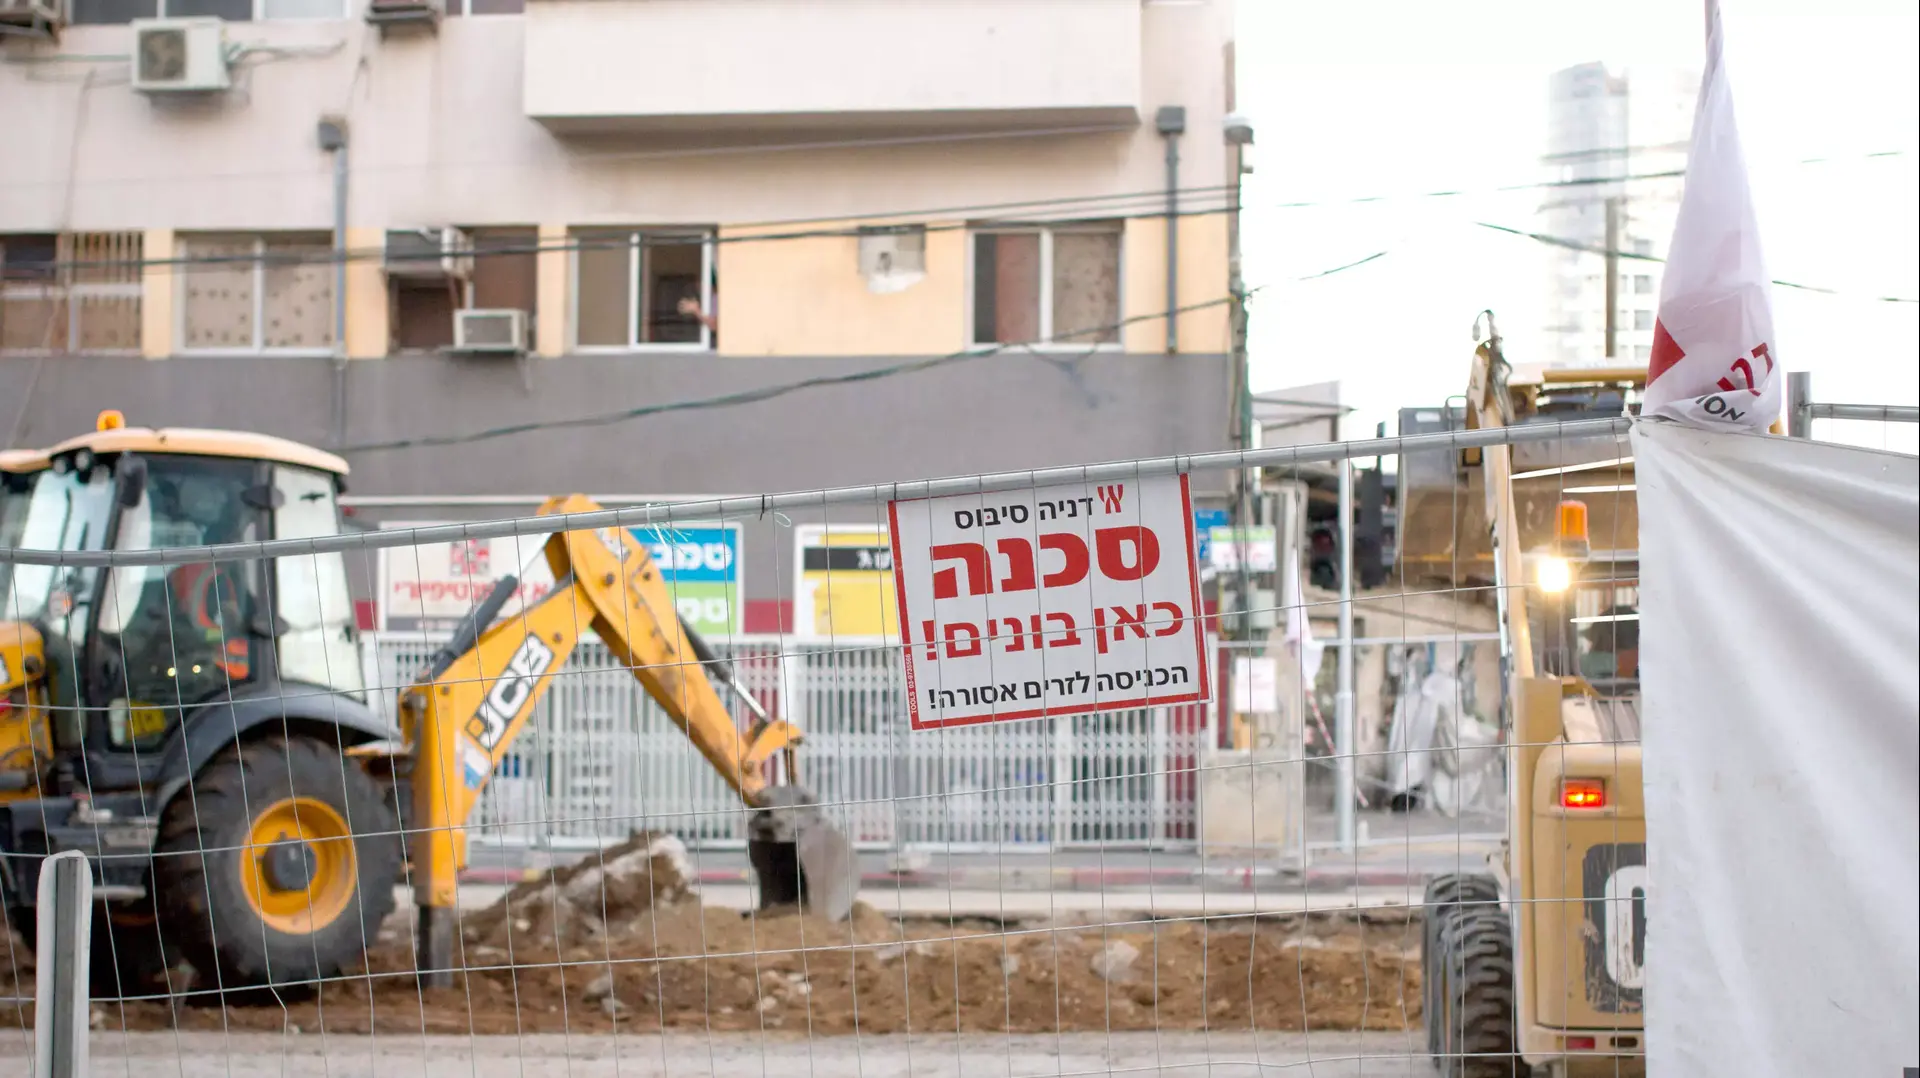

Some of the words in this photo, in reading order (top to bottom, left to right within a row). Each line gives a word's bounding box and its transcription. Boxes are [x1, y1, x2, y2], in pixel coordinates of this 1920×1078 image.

[955, 504, 1029, 529] סיבוס
[1039, 497, 1093, 521] דניה
[930, 526, 1160, 600] סכנה
[922, 612, 1081, 661] בונים!
[1094, 602, 1184, 654] כאן
[478, 634, 554, 750] JCB
[1024, 671, 1091, 699] לזרים
[1097, 665, 1189, 692] הכניסה
[909, 691, 917, 714] TOOLS
[928, 683, 1018, 710] אסורה!
